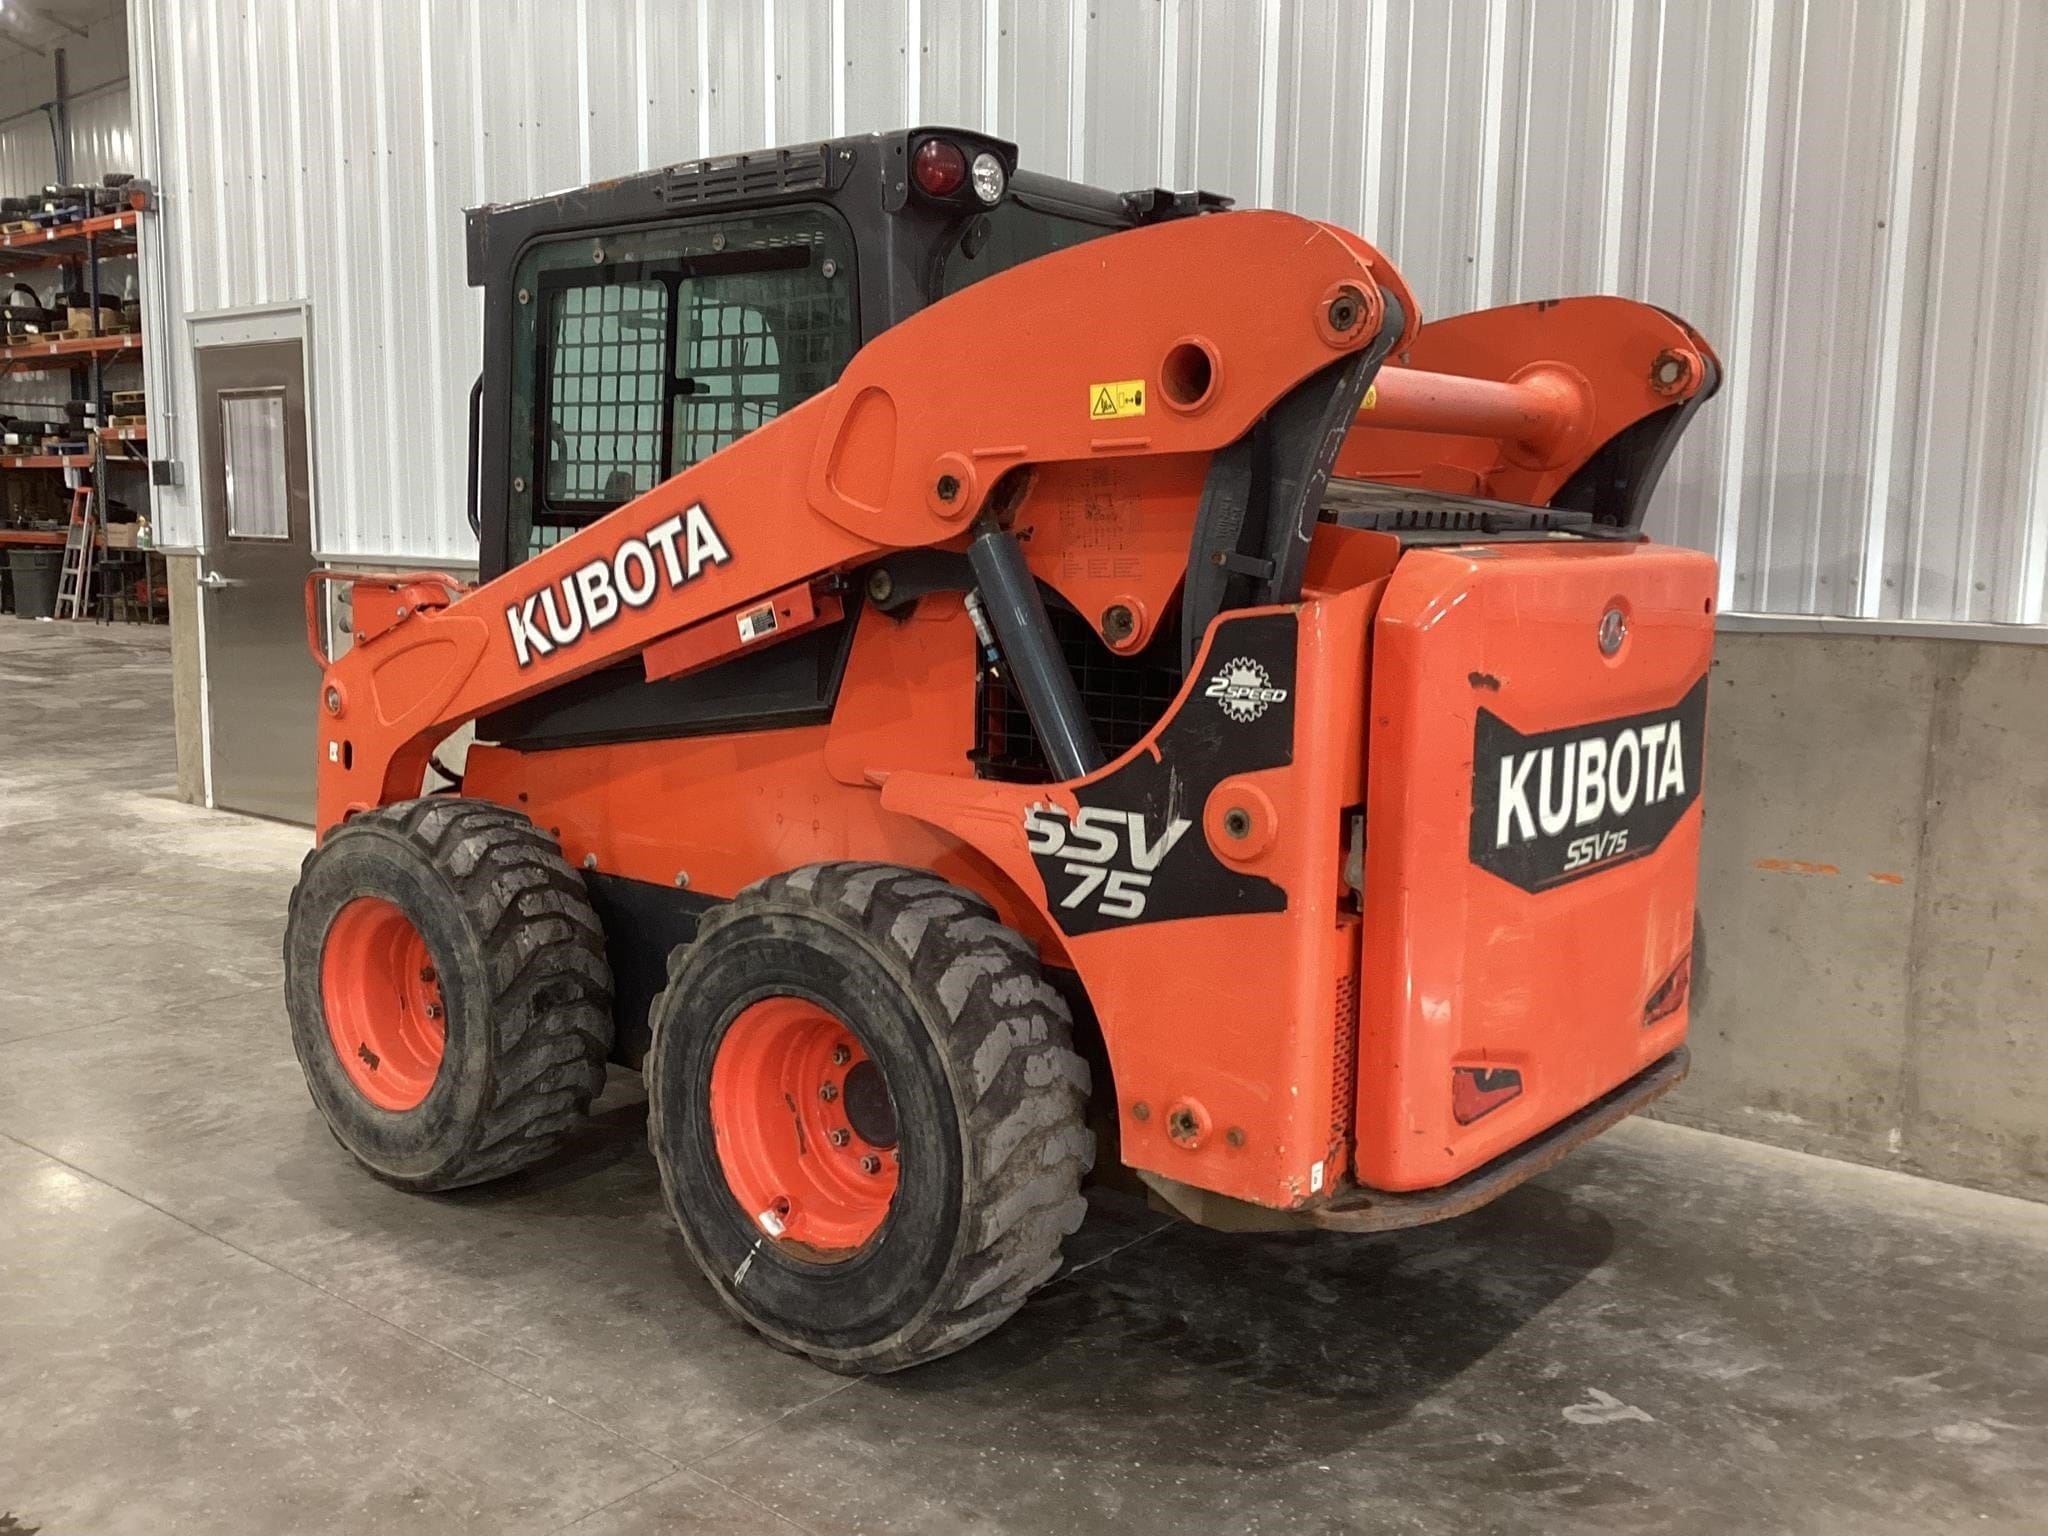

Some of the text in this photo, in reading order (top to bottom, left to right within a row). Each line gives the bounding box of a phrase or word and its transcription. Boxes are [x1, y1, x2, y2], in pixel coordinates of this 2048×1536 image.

[506, 504, 730, 666] KUBOTA
[1496, 719, 1686, 850] KUBOTA
[1024, 801, 1193, 872] SSV
[1060, 862, 1153, 919] 75
